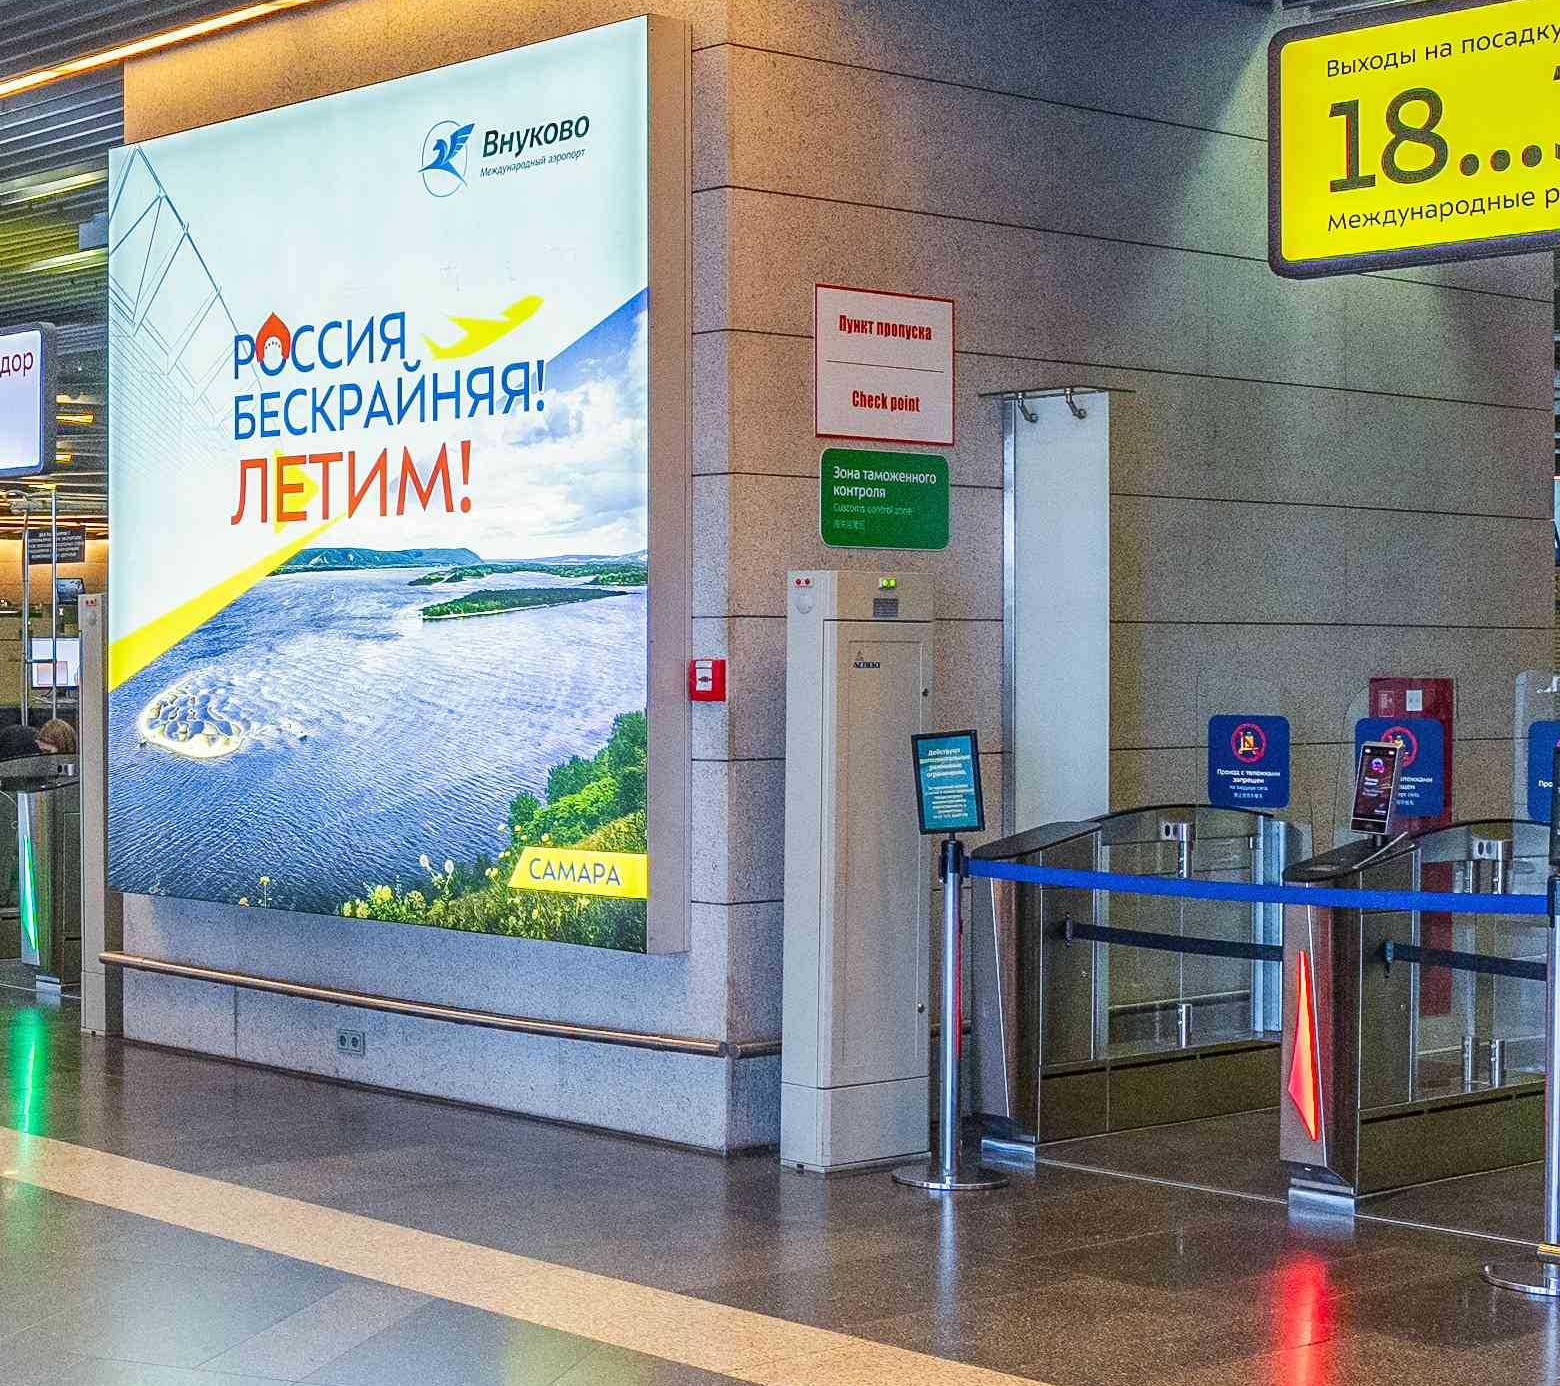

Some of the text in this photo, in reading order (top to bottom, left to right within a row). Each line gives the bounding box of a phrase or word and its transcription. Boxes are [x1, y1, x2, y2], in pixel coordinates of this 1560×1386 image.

[1326, 44, 1417, 78] Выходы
[1423, 43, 1453, 61] на
[482, 115, 590, 158] Внуково
[480, 149, 586, 177] Международный аэропорт
[1327, 188, 1537, 232] Международные
[839, 314, 932, 341] Пункт пропуска
[234, 311, 406, 379] РОССИЯ
[233, 359, 546, 440] БЕСКРАЙНЯЯ!
[852, 390, 921, 413] Check point
[230, 439, 472, 526] ЛЕТИМ!
[833, 466, 937, 484] Зона таможенного
[833, 486, 886, 500] контроля
[528, 857, 622, 887] САМАРА
